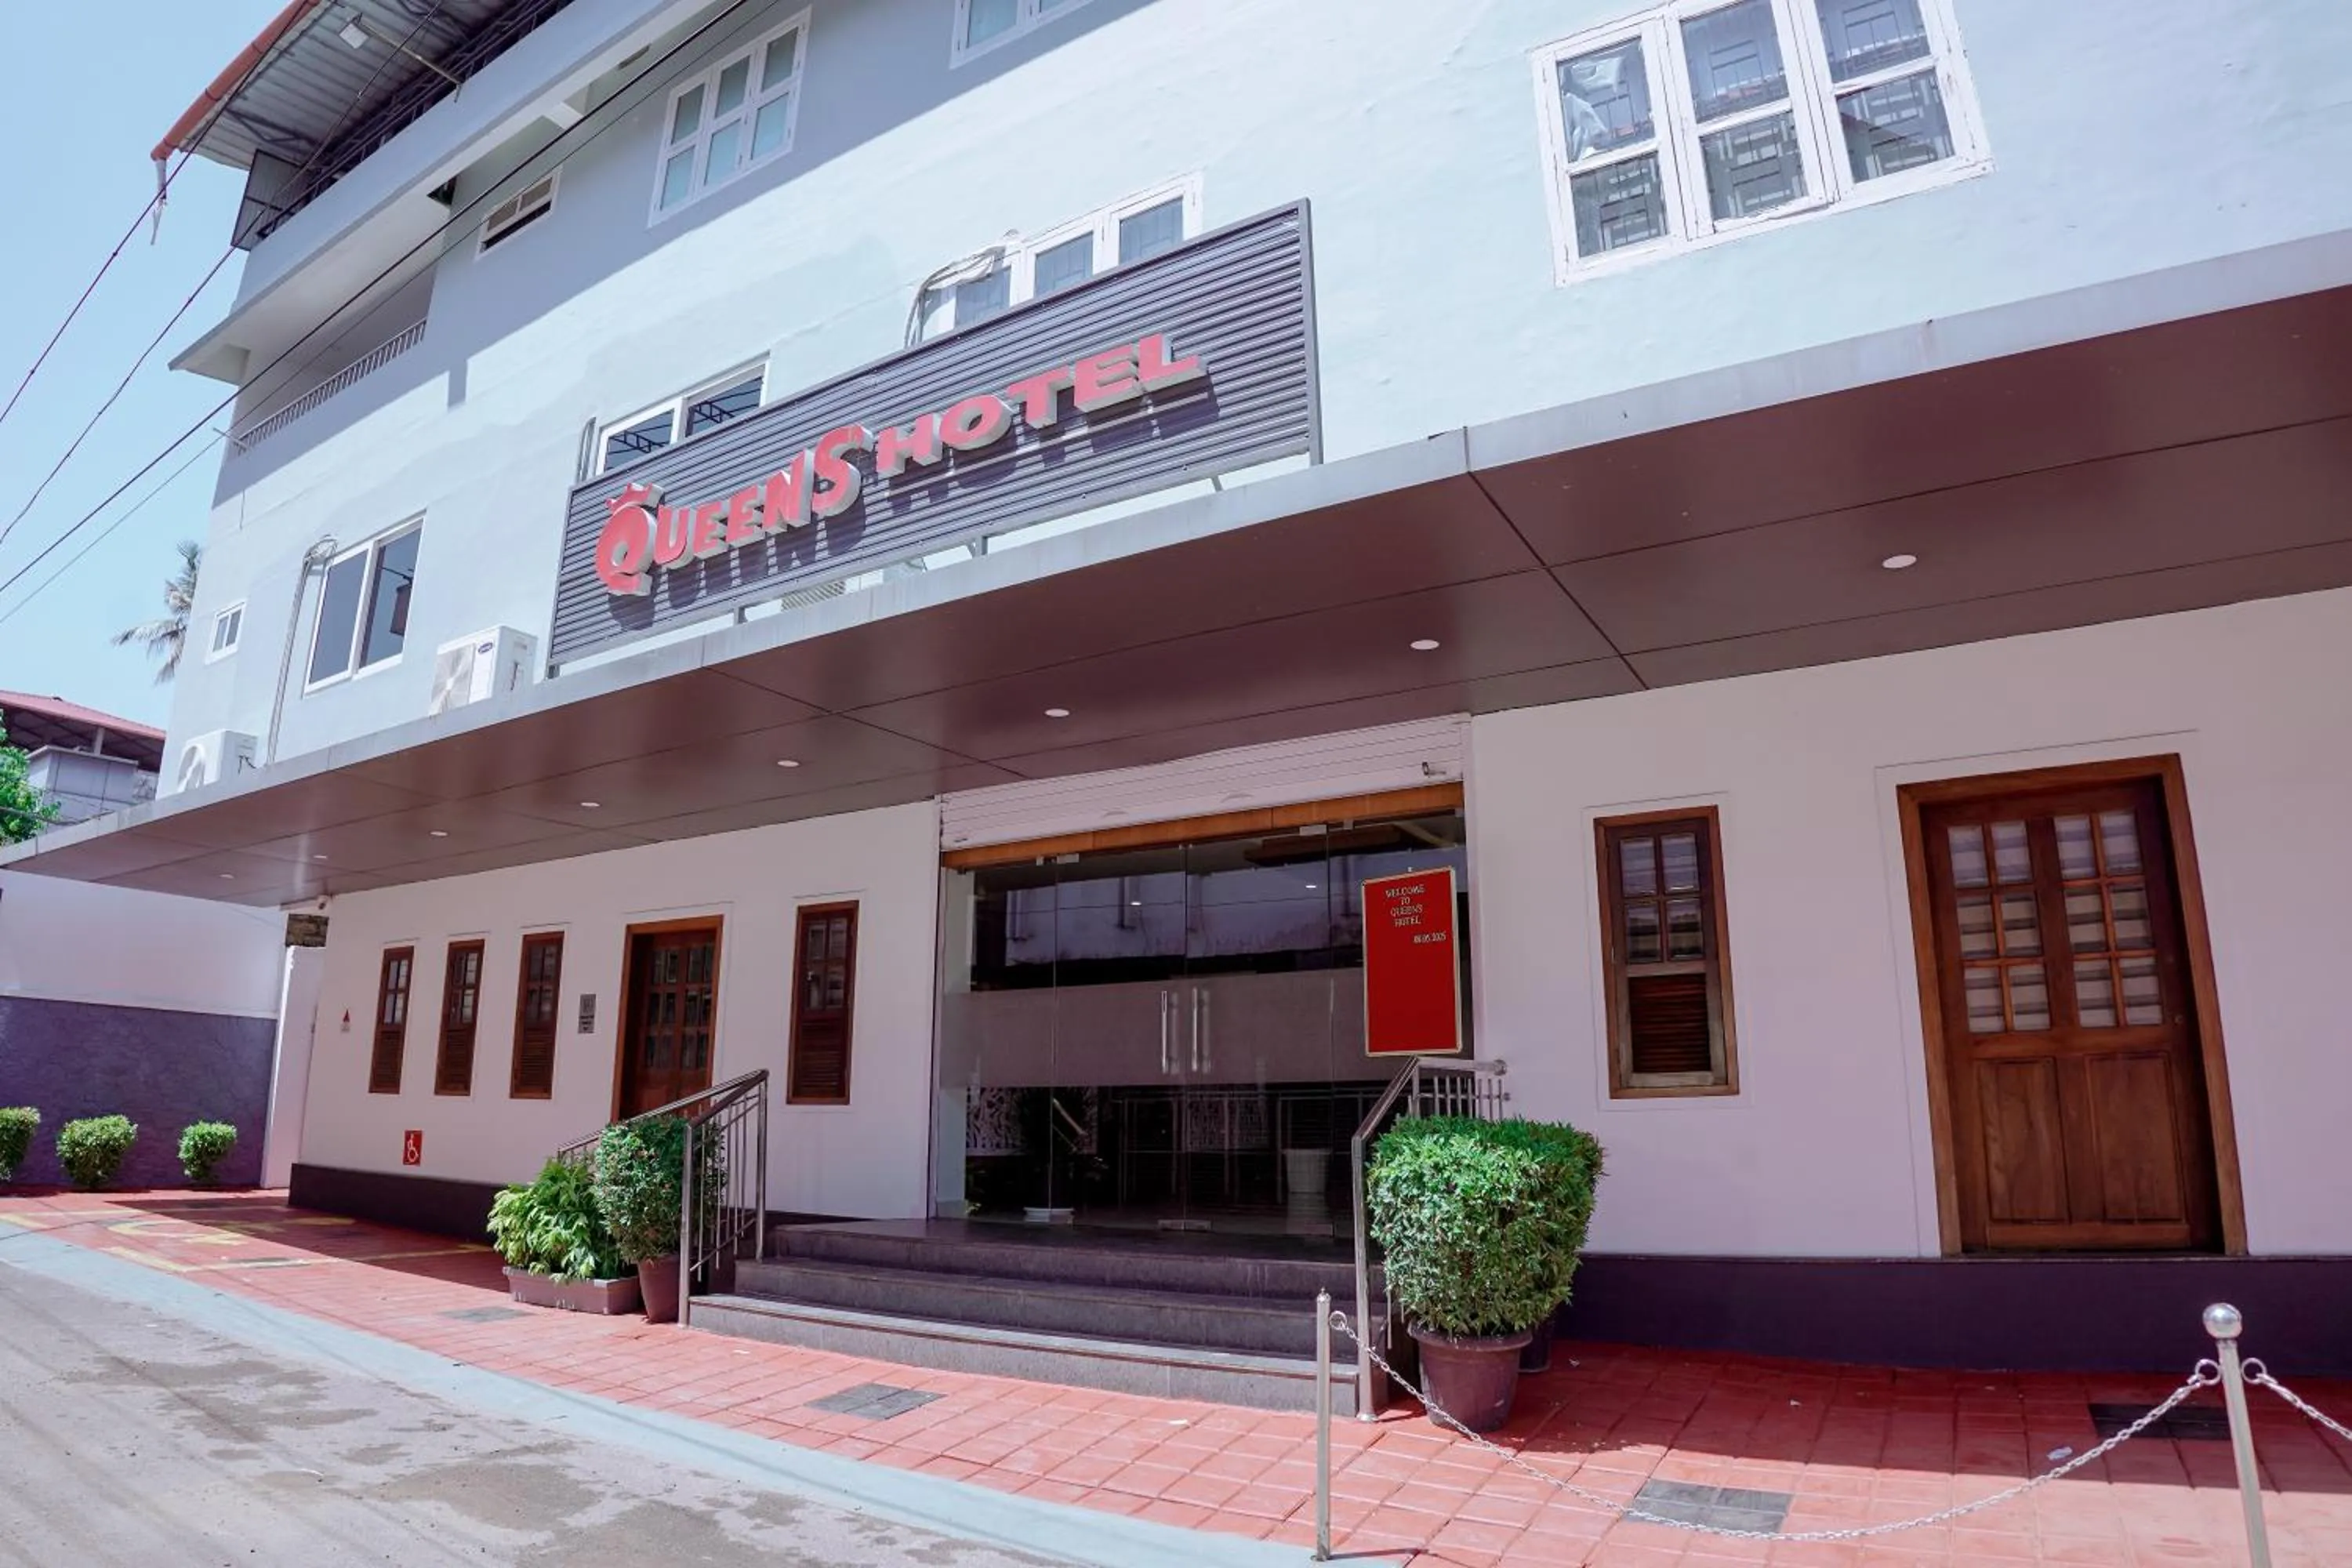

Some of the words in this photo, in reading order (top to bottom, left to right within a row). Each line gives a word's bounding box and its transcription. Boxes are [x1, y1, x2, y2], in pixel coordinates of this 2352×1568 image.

[595, 423, 873, 596] QUEENS
[876, 332, 1208, 475] HOTEL
[1385, 884, 1425, 898] WELCOME
[1400, 896, 1410, 906] TO
[1395, 915, 1421, 927] HOTEL
